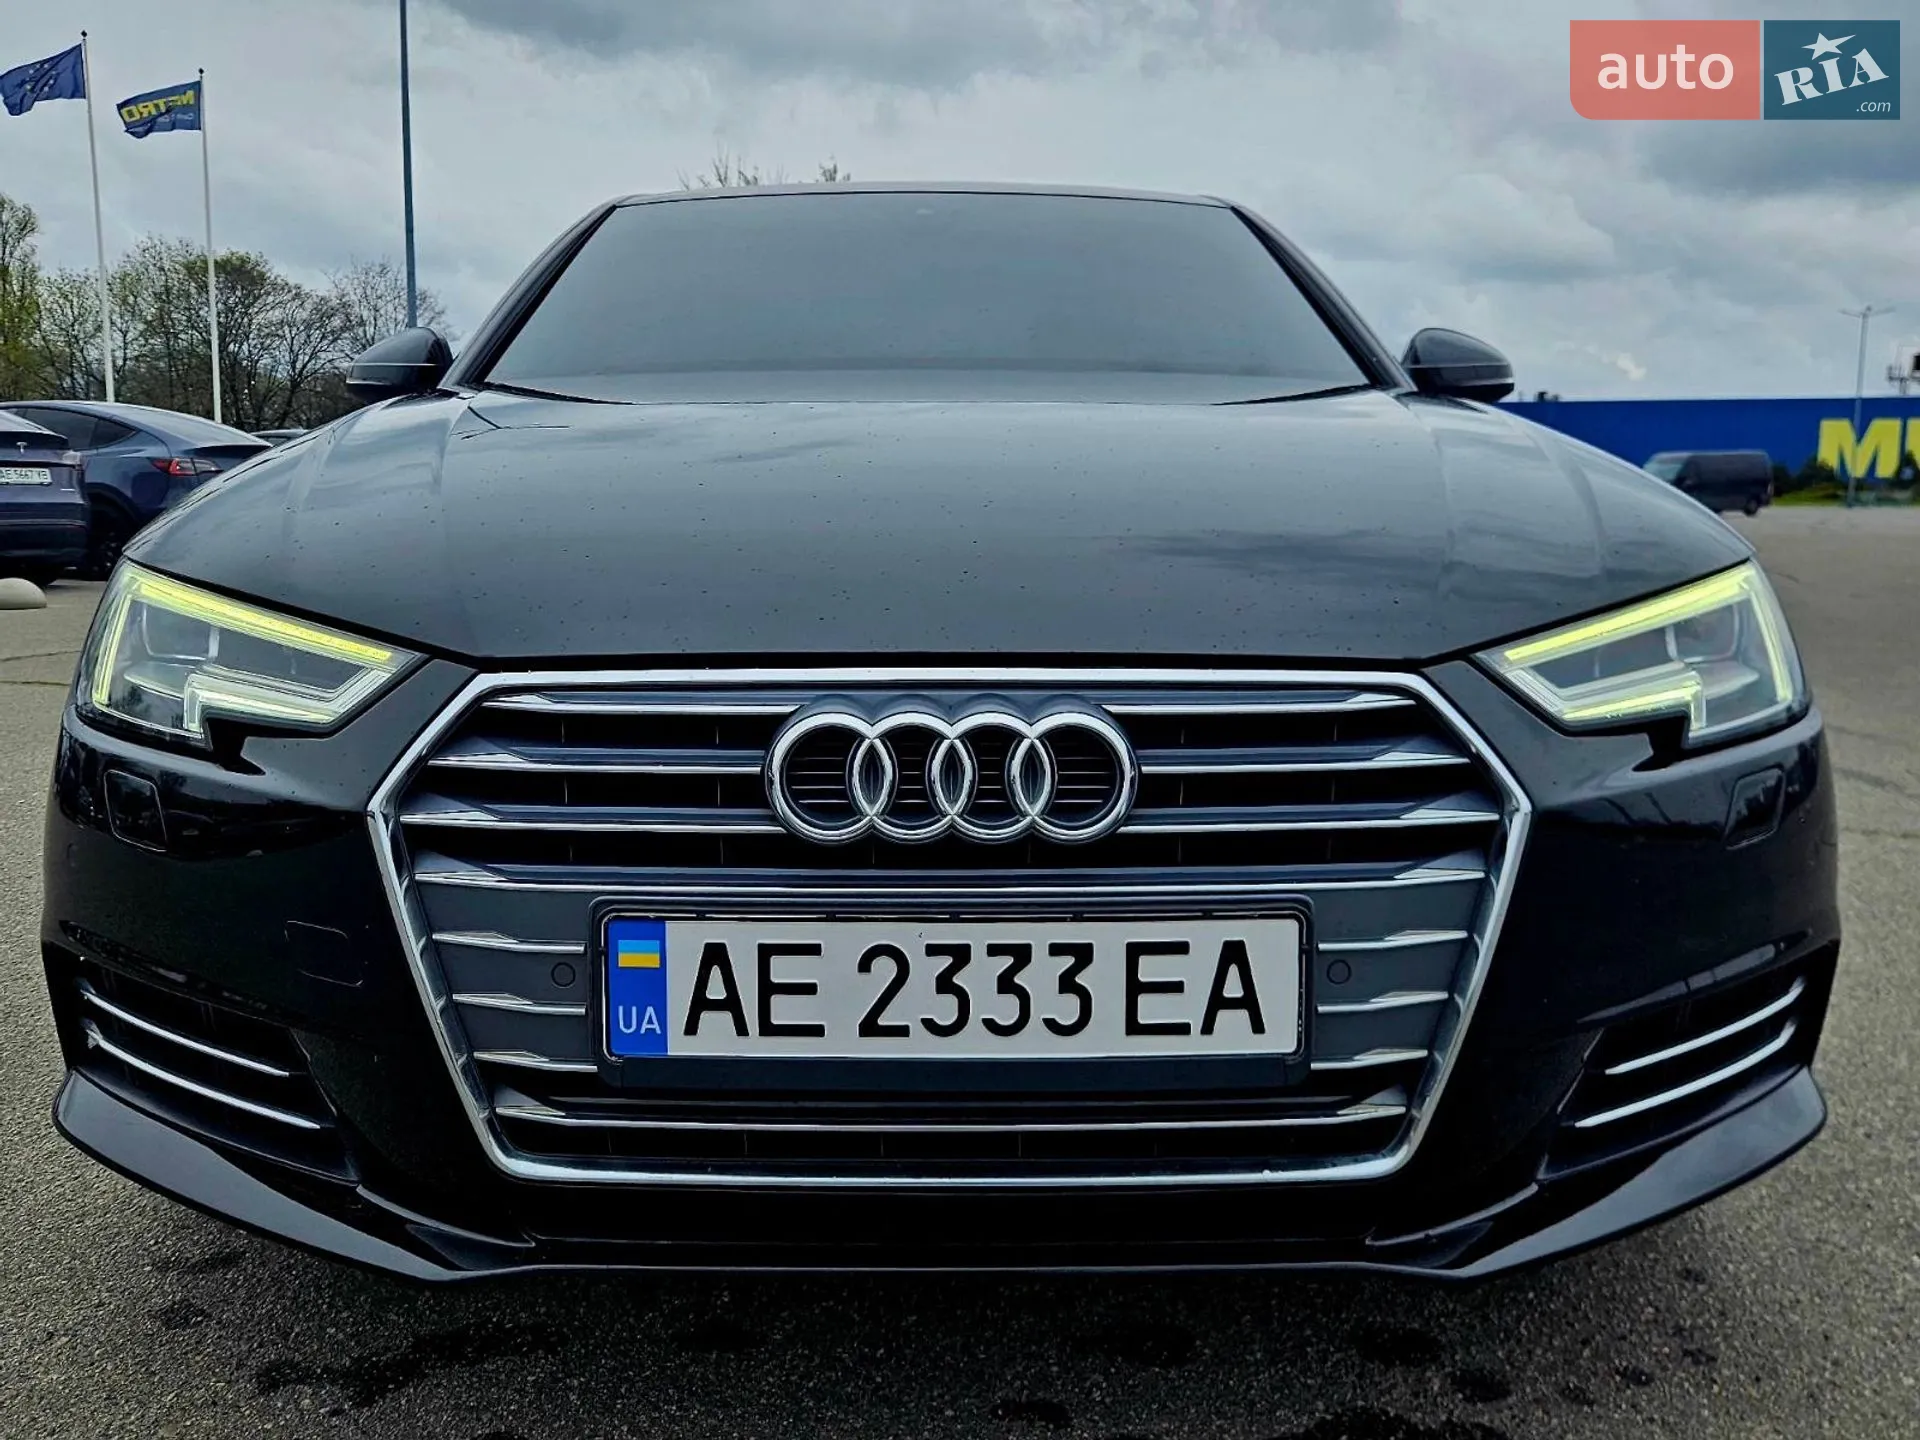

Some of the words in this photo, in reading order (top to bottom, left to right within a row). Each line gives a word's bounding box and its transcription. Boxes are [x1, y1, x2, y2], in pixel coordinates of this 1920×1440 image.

[618, 1005, 661, 1034] UA
[683, 942, 826, 1038] AE
[857, 942, 1095, 1038] 2333
[1124, 939, 1266, 1037] EA
